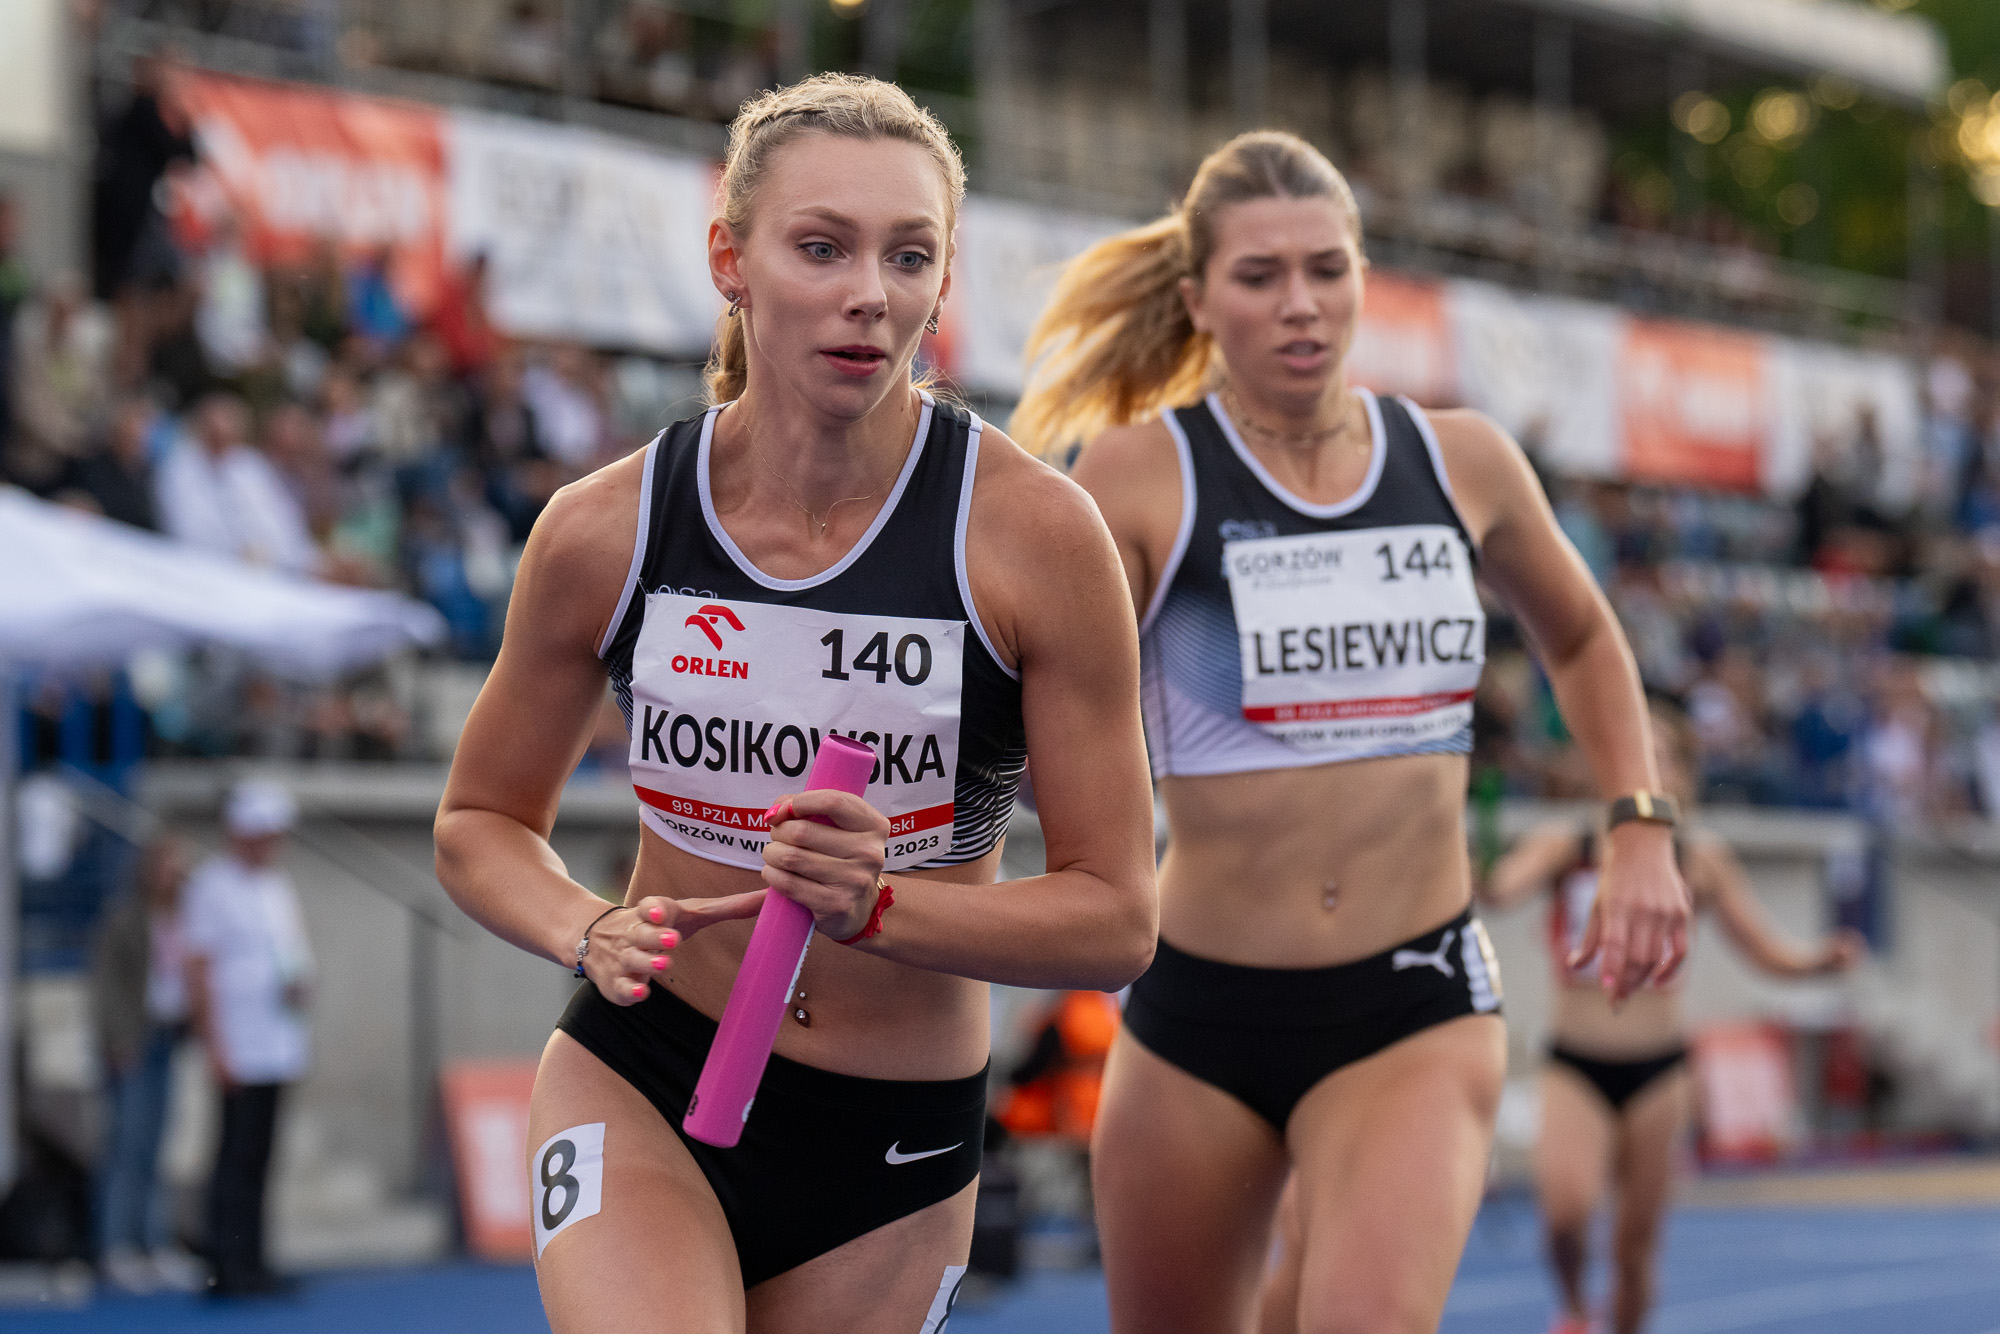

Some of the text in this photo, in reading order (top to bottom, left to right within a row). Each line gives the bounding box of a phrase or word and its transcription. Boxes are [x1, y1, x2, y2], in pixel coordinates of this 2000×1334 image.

[1234, 545, 1344, 577] GORZÓW
[1376, 540, 1452, 581] 144
[820, 628, 932, 687] 140
[1254, 618, 1475, 675] LESIEWICZ
[671, 655, 749, 680] ORLEN
[671, 799, 698, 816] 99.
[702, 806, 742, 826] PZLA
[893, 835, 939, 858] 2023
[540, 1138, 580, 1231] 8
